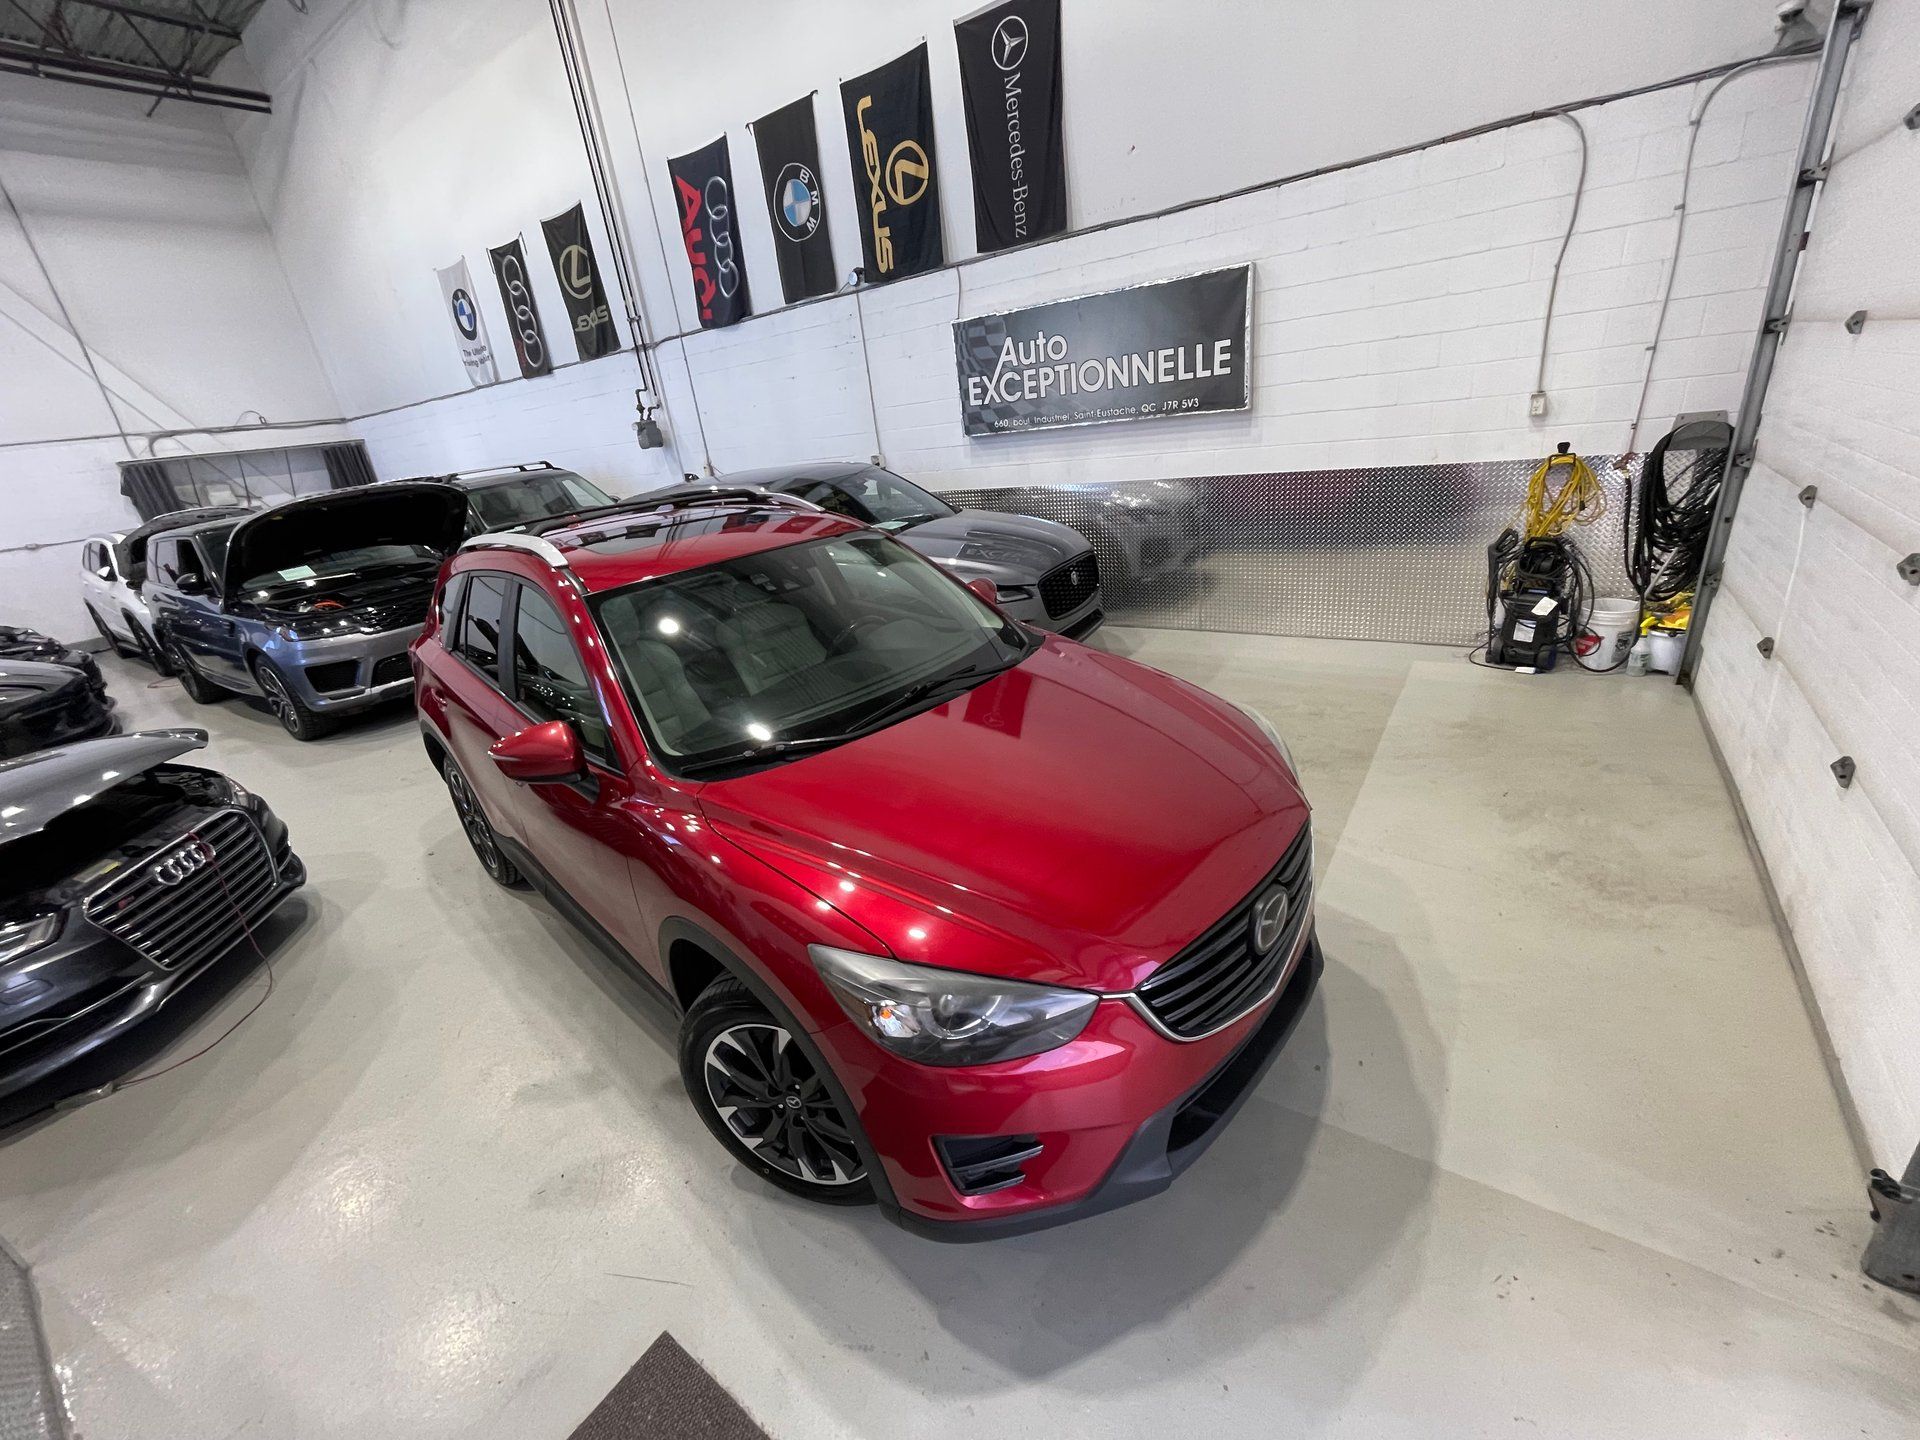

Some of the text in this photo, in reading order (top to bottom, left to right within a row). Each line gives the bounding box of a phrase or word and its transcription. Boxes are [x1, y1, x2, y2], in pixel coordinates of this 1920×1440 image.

[856, 95, 894, 274] LEXUS
[1004, 72, 1029, 238] Mercedes-Benz
[800, 168, 820, 232] BMW
[968, 339, 1232, 407] EXCEPTIONNELLE
[1000, 331, 1068, 367] Auto
[1141, 403, 1157, 413] QC
[1162, 401, 1179, 411] J7R
[1182, 398, 1199, 409] 5V3
